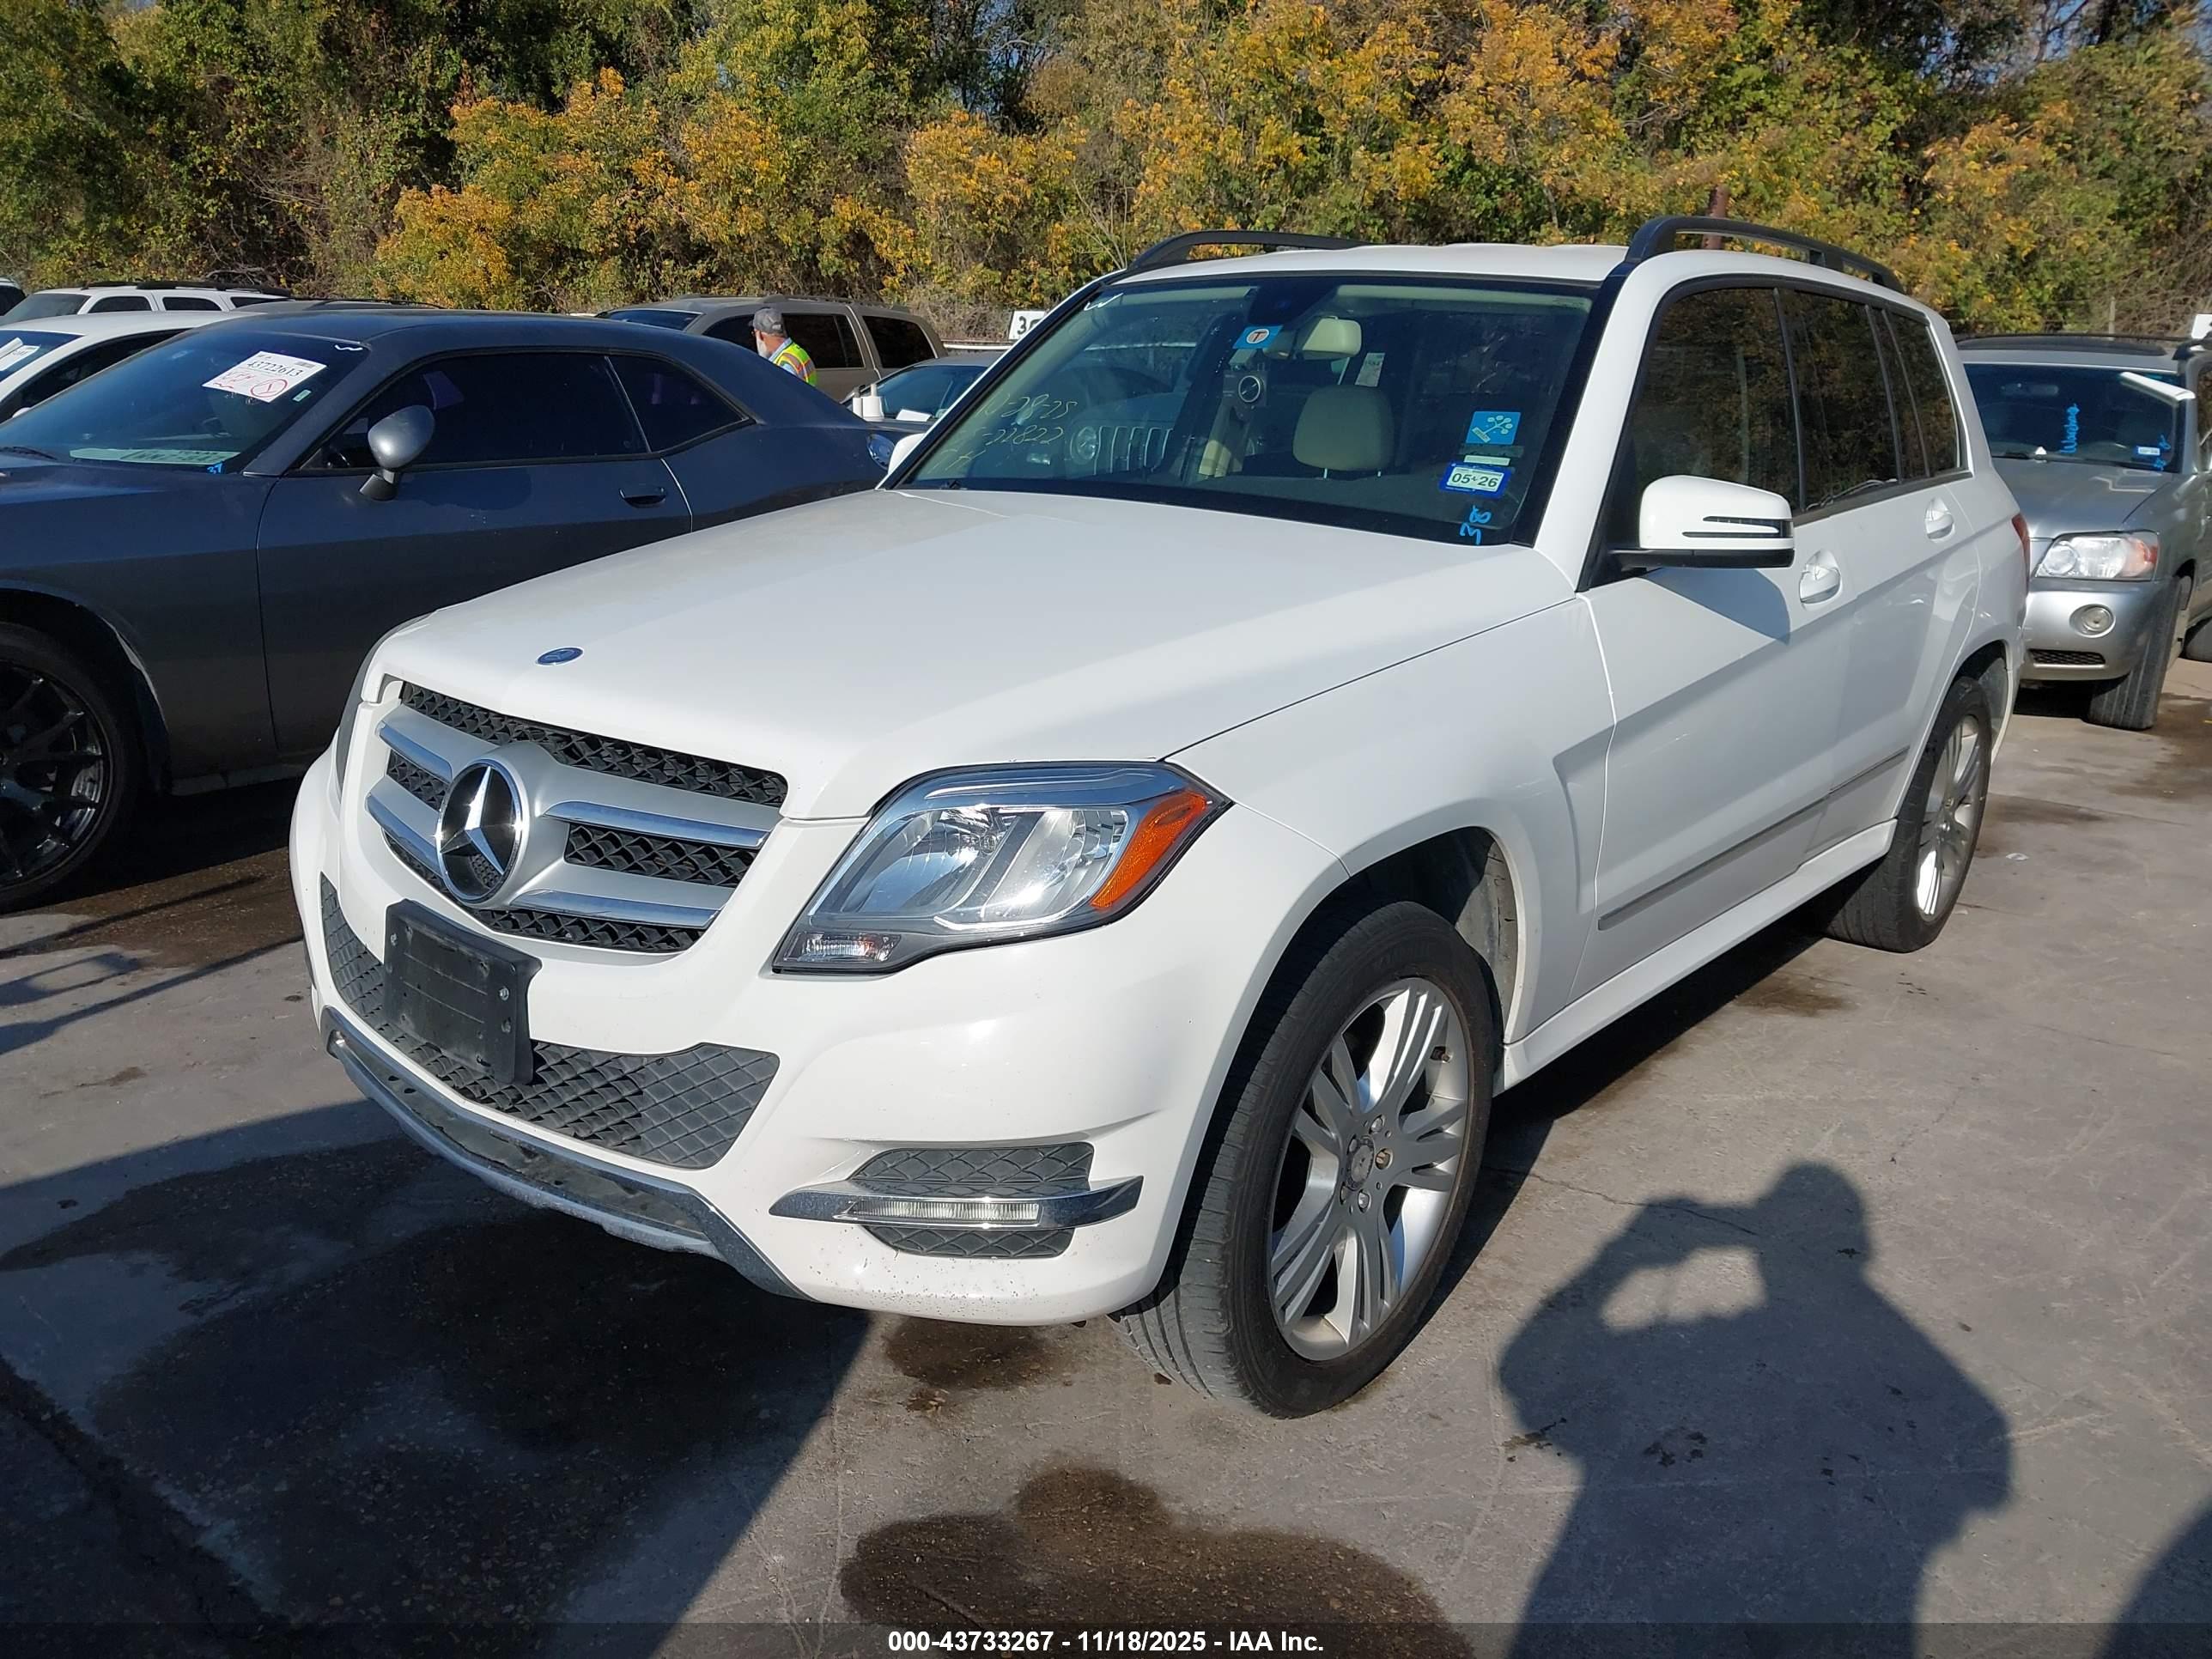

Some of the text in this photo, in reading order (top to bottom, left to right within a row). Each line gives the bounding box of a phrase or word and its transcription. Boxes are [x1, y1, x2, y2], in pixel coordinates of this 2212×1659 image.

[247, 360, 303, 377] 43722613
[1452, 473, 1498, 488] 05 26
